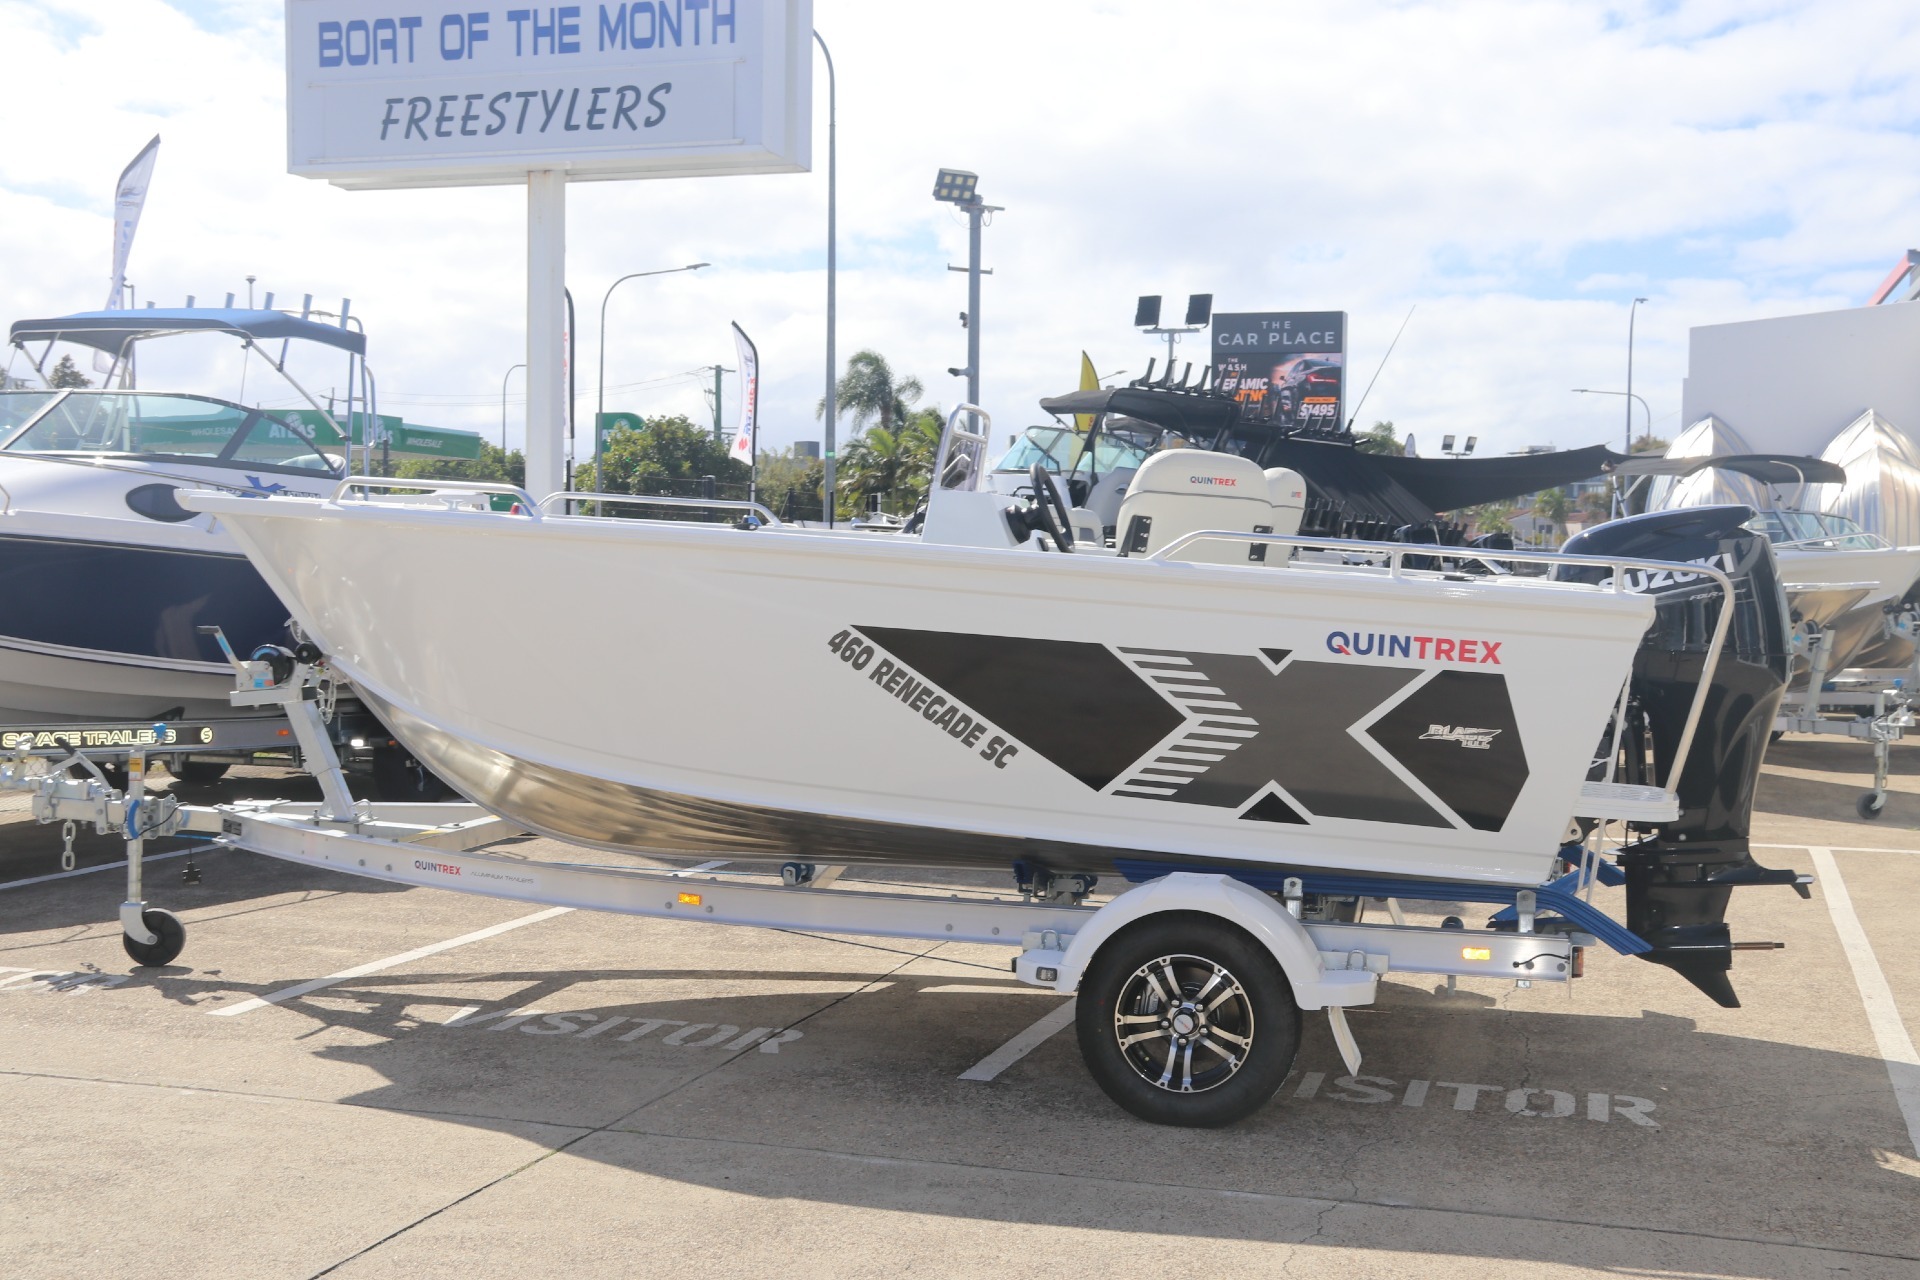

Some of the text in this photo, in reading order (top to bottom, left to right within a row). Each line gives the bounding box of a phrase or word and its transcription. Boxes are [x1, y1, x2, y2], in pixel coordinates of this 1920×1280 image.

[318, 0, 736, 68] BOAT OF THE MONTH
[380, 82, 673, 142] FREESTYLERS
[1261, 320, 1292, 329] THE
[1218, 331, 1336, 346] CAR PLACE
[1217, 363, 1248, 371] WASH
[1299, 403, 1336, 416] $1495
[1190, 475, 1237, 487] QUINTREX
[1326, 630, 1502, 665] QUINTREX
[827, 629, 1019, 770] 460 RENEGADE SC
[414, 860, 461, 876] QUINTREX
[441, 1004, 804, 1054] VISITOR
[1292, 1071, 1661, 1128] ISITOR
